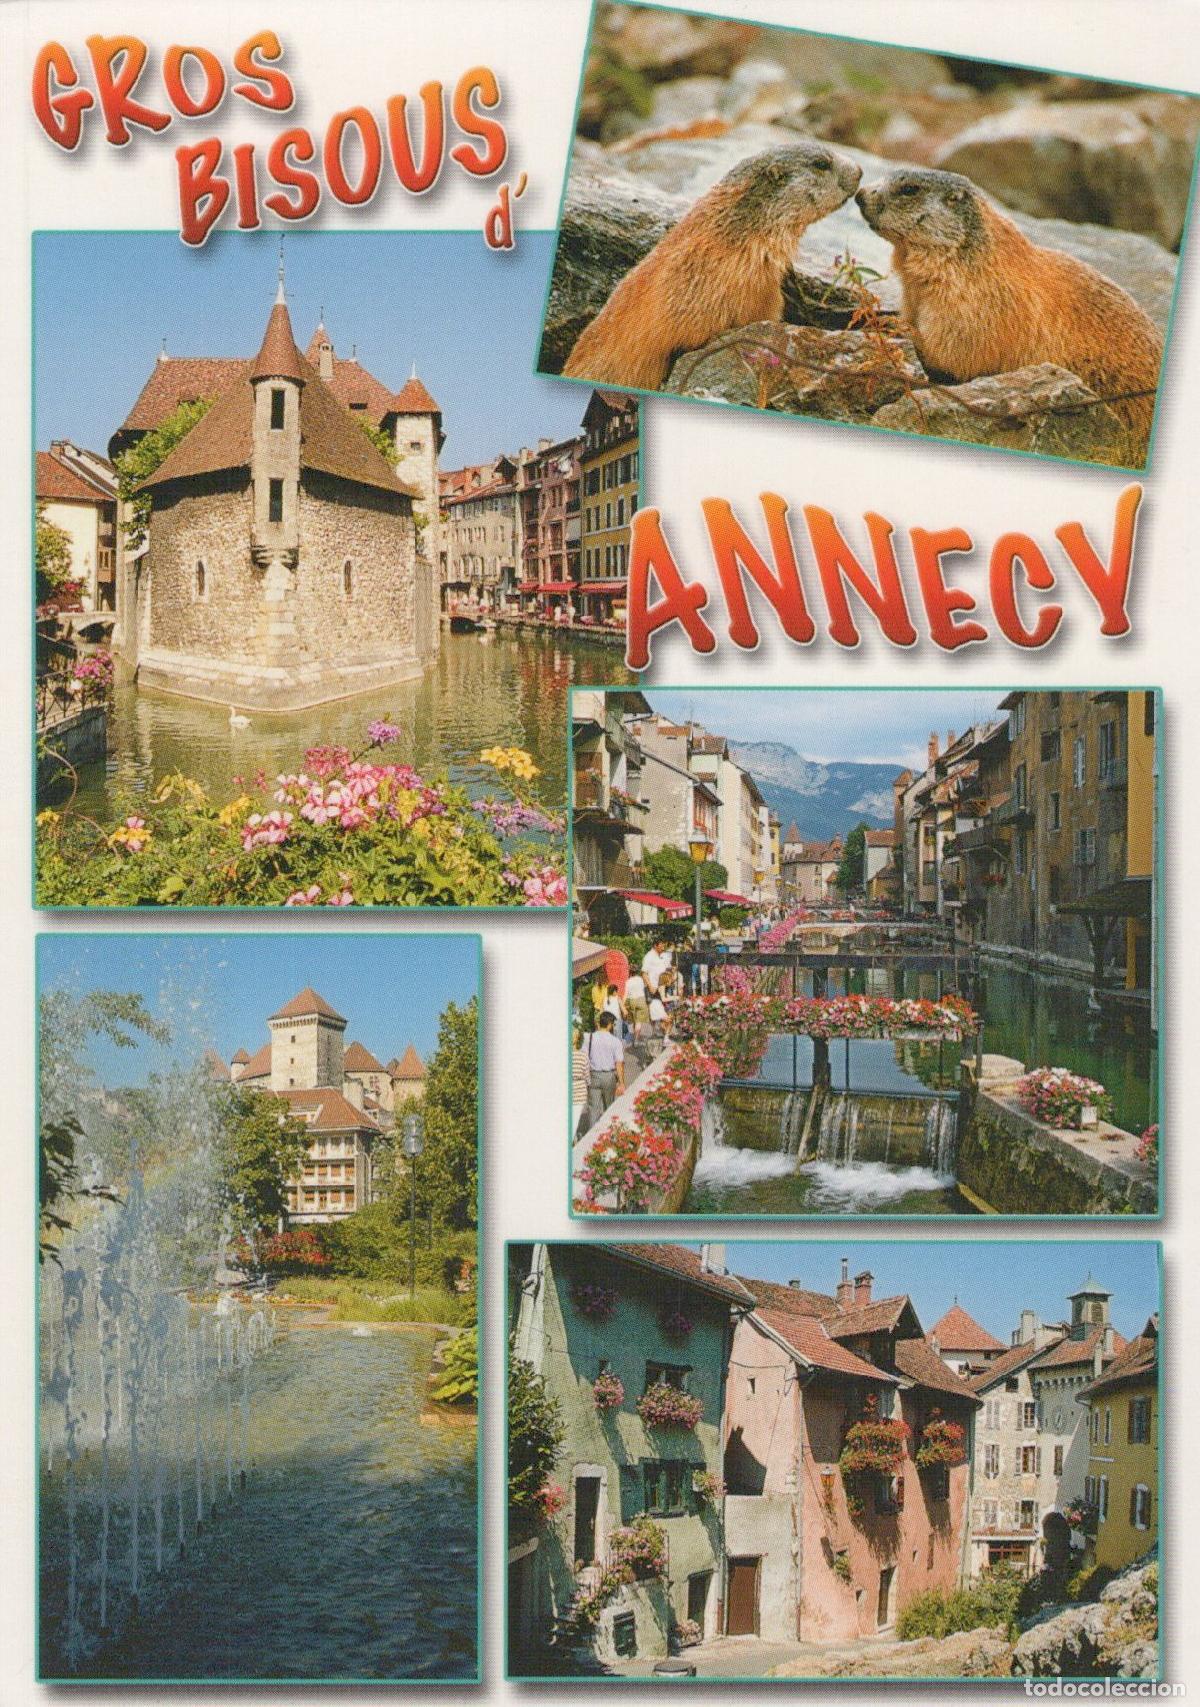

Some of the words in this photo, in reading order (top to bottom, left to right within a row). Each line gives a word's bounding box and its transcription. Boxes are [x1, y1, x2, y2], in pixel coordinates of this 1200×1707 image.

[32, 30, 296, 152] GROS
[174, 66, 509, 247] BISOUS
[624, 482, 1144, 671] ANNECY
